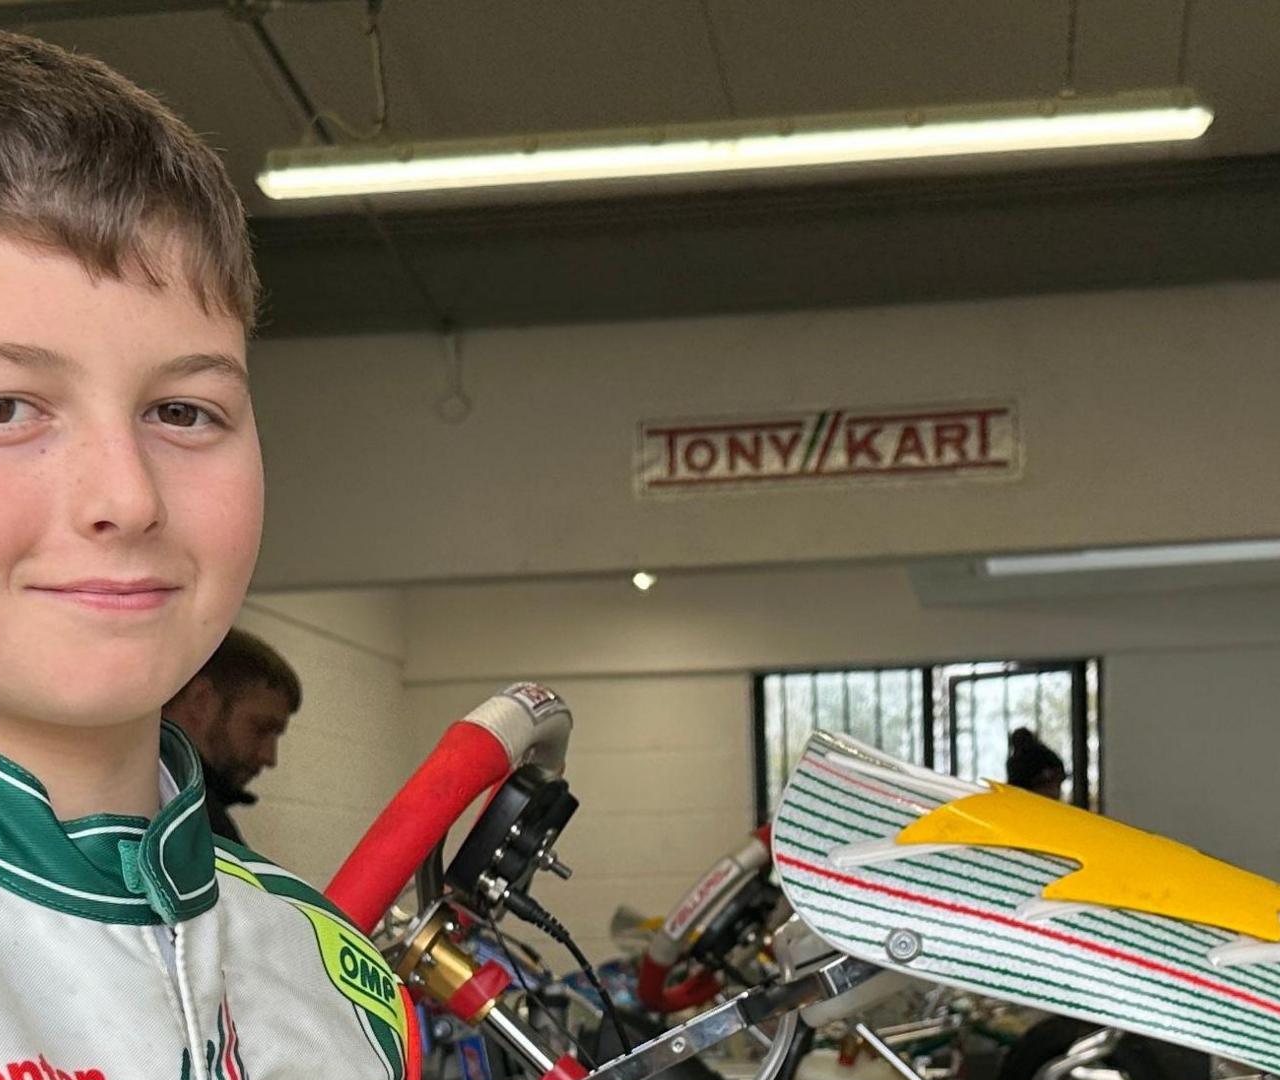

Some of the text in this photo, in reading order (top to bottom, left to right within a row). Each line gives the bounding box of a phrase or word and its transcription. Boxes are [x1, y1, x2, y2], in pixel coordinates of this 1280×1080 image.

[646, 408, 1008, 475] TONY KART
[340, 946, 396, 1003] OMP
